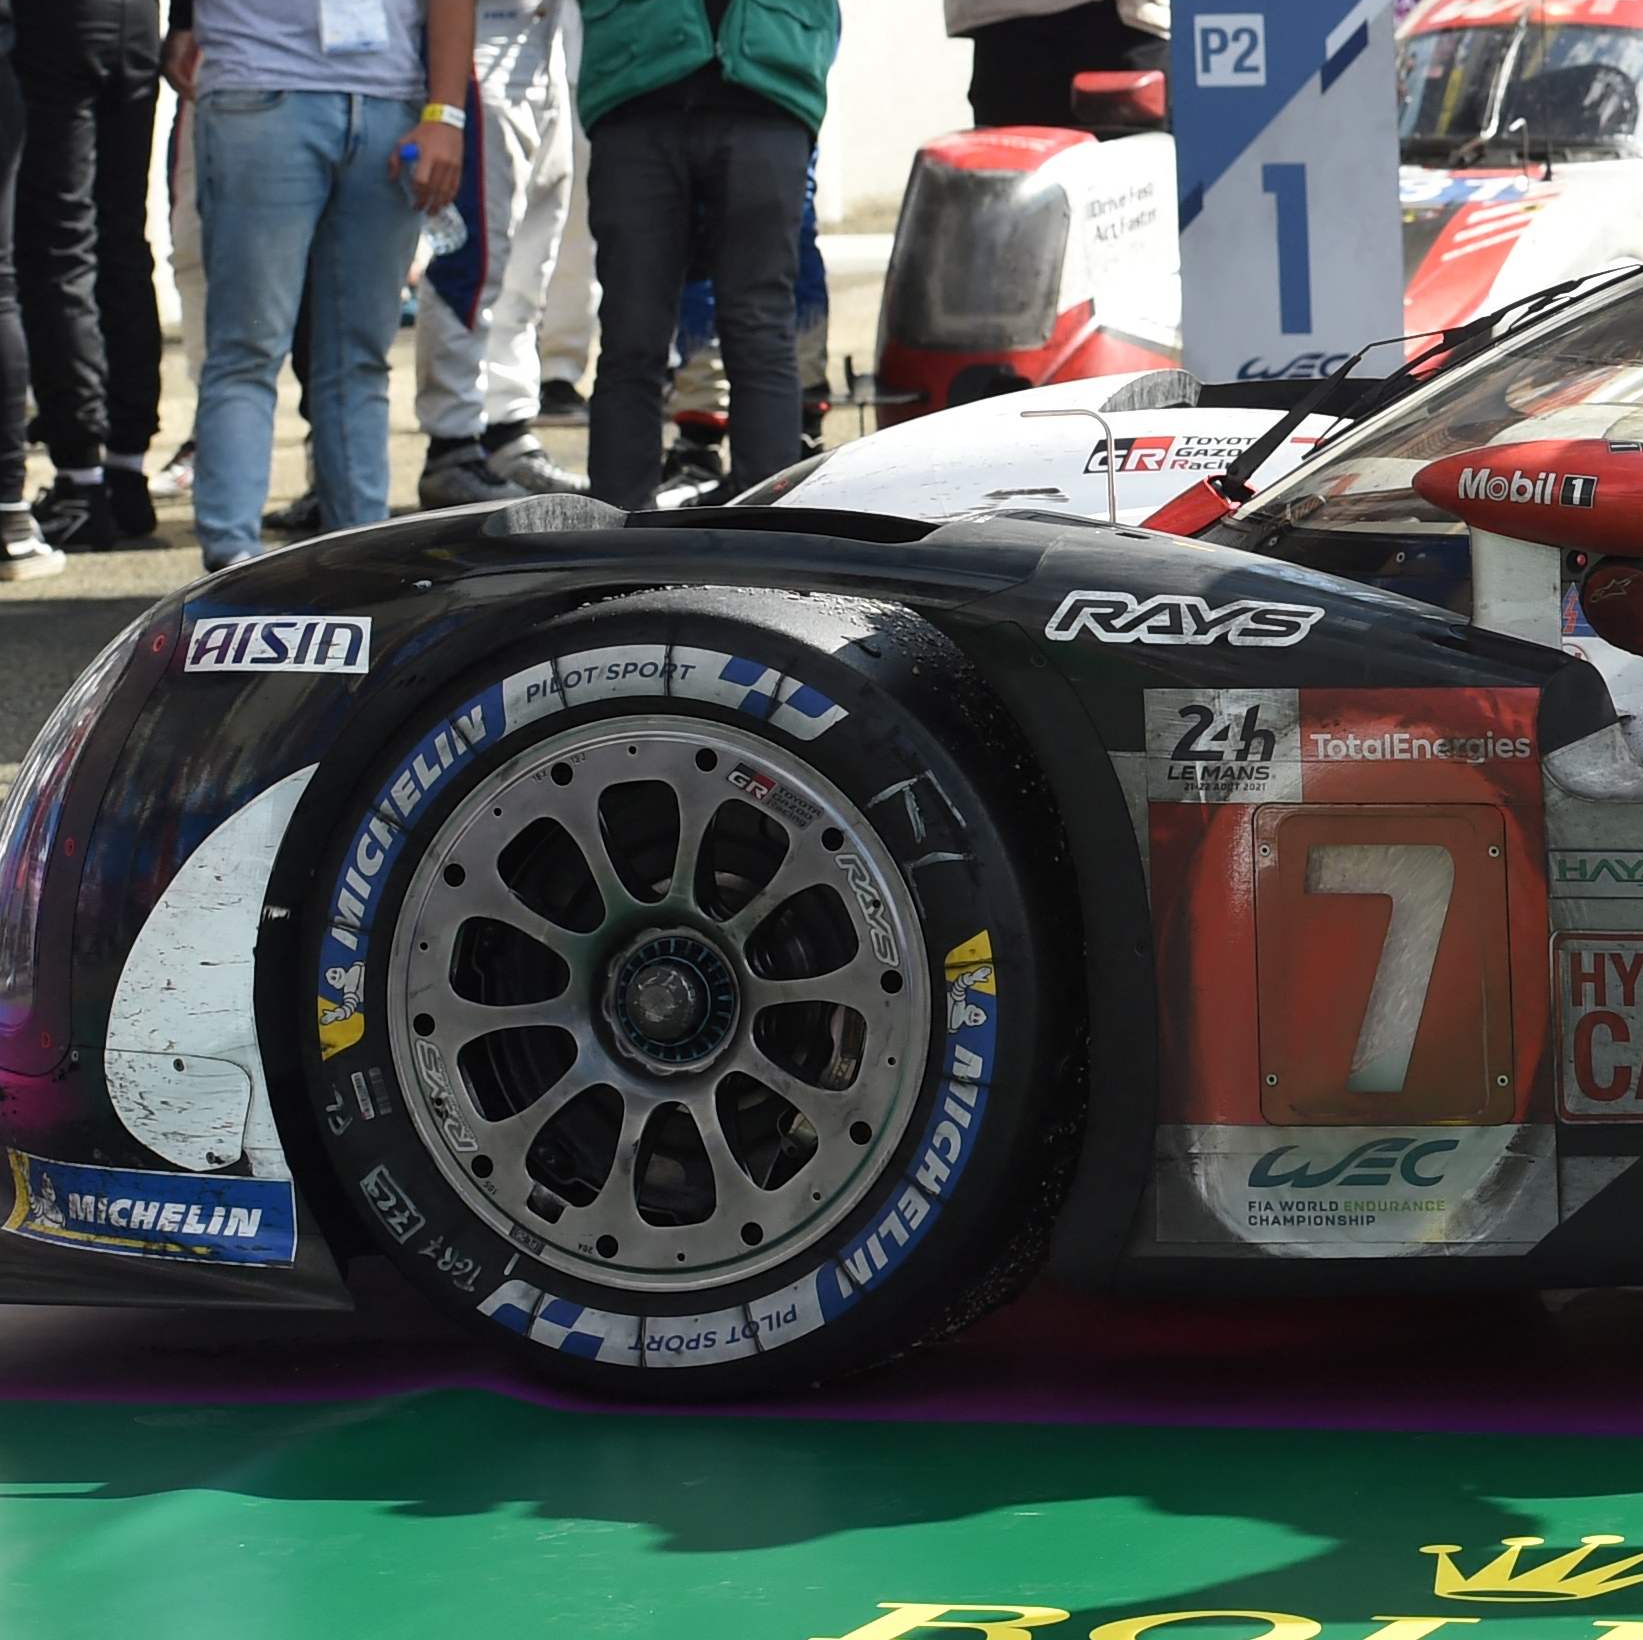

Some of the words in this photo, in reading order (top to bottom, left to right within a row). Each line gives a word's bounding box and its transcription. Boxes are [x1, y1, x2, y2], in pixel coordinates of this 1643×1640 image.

[1199, 26, 1262, 75] P2
[1261, 162, 1313, 335] 1
[1175, 447, 1242, 458] GAZO
[1181, 436, 1257, 446] TOYOT
[1456, 467, 1557, 505] Mobil
[1049, 592, 1324, 644] RAYS
[187, 620, 367, 669] AISIN
[523, 664, 600, 707] PILOT
[604, 660, 697, 684] SPORT
[1170, 703, 1277, 762] 24h
[1310, 731, 1532, 765] TotalEnergies
[727, 769, 769, 800] GR
[1166, 765, 1197, 781] LE
[1200, 765, 1271, 781] MANS
[329, 700, 489, 952] MICHELIN
[834, 852, 899, 968] RAYS
[1303, 842, 1457, 1094] 7
[415, 1038, 480, 1153] RAYS
[837, 1043, 985, 1300] MICHELIN
[1247, 1135, 1461, 1189] WEC
[66, 1189, 263, 1239] MICHELIN
[1247, 1199, 1274, 1213] FIA
[1278, 1199, 1340, 1213] WORLD
[1343, 1198, 1447, 1212] ENDURANCE
[1247, 1214, 1377, 1227] CHAMPIONSHIP
[628, 1330, 718, 1353] SPORT
[725, 1304, 798, 1346] PILOT
